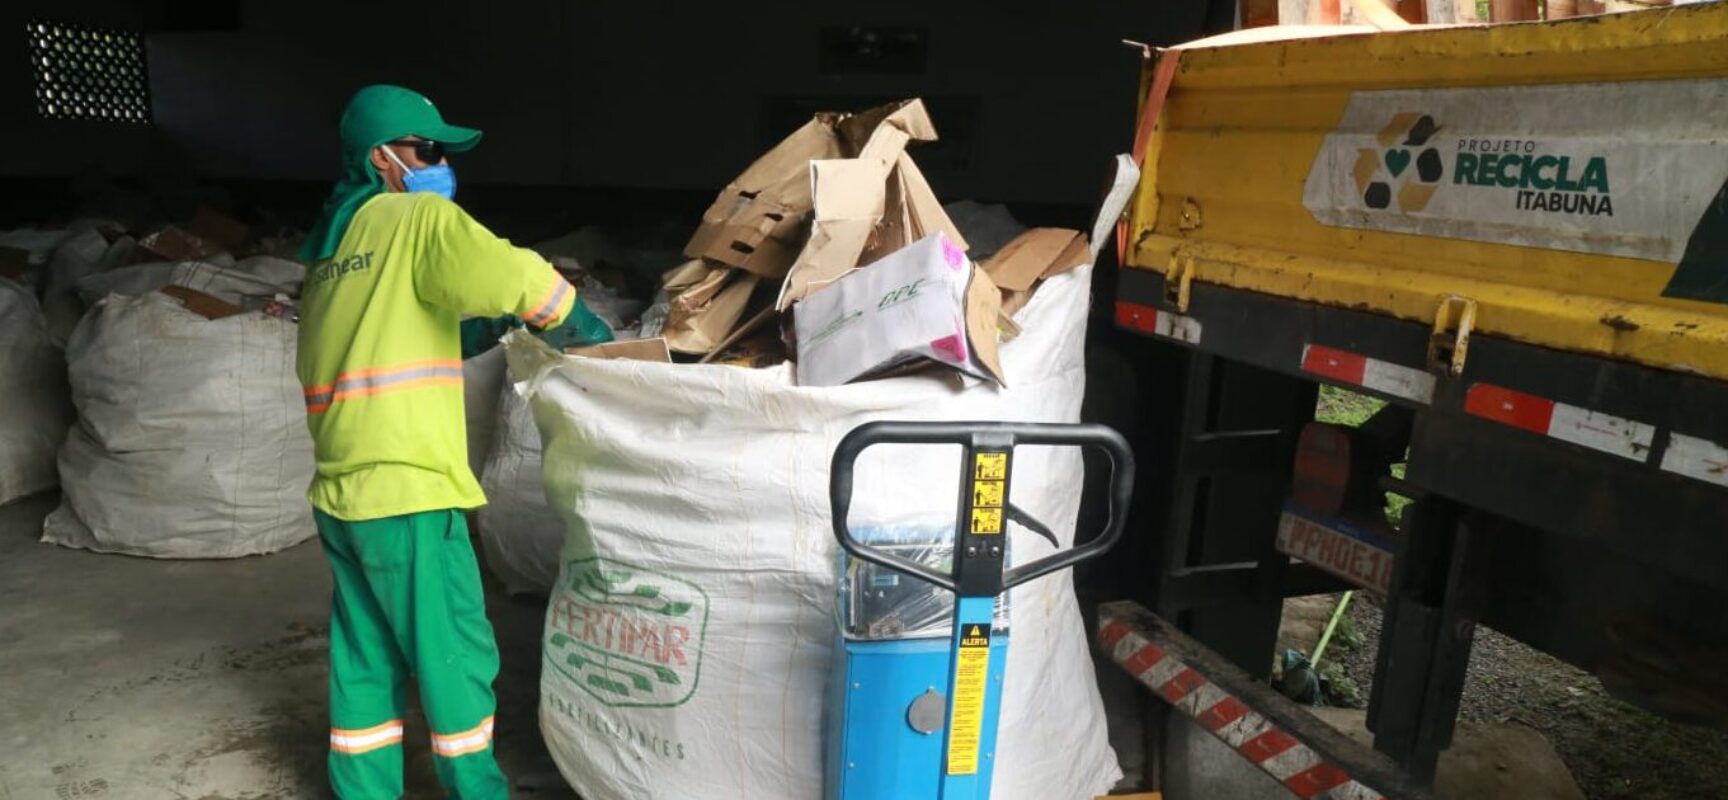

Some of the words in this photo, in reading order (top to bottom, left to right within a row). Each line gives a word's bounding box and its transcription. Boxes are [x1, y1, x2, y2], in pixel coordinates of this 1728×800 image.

[1457, 138, 1536, 153] PROJETO
[1453, 152, 1611, 194] RECICLA
[1515, 190, 1614, 217] ITABUNA
[961, 638, 988, 646] ALERTA
